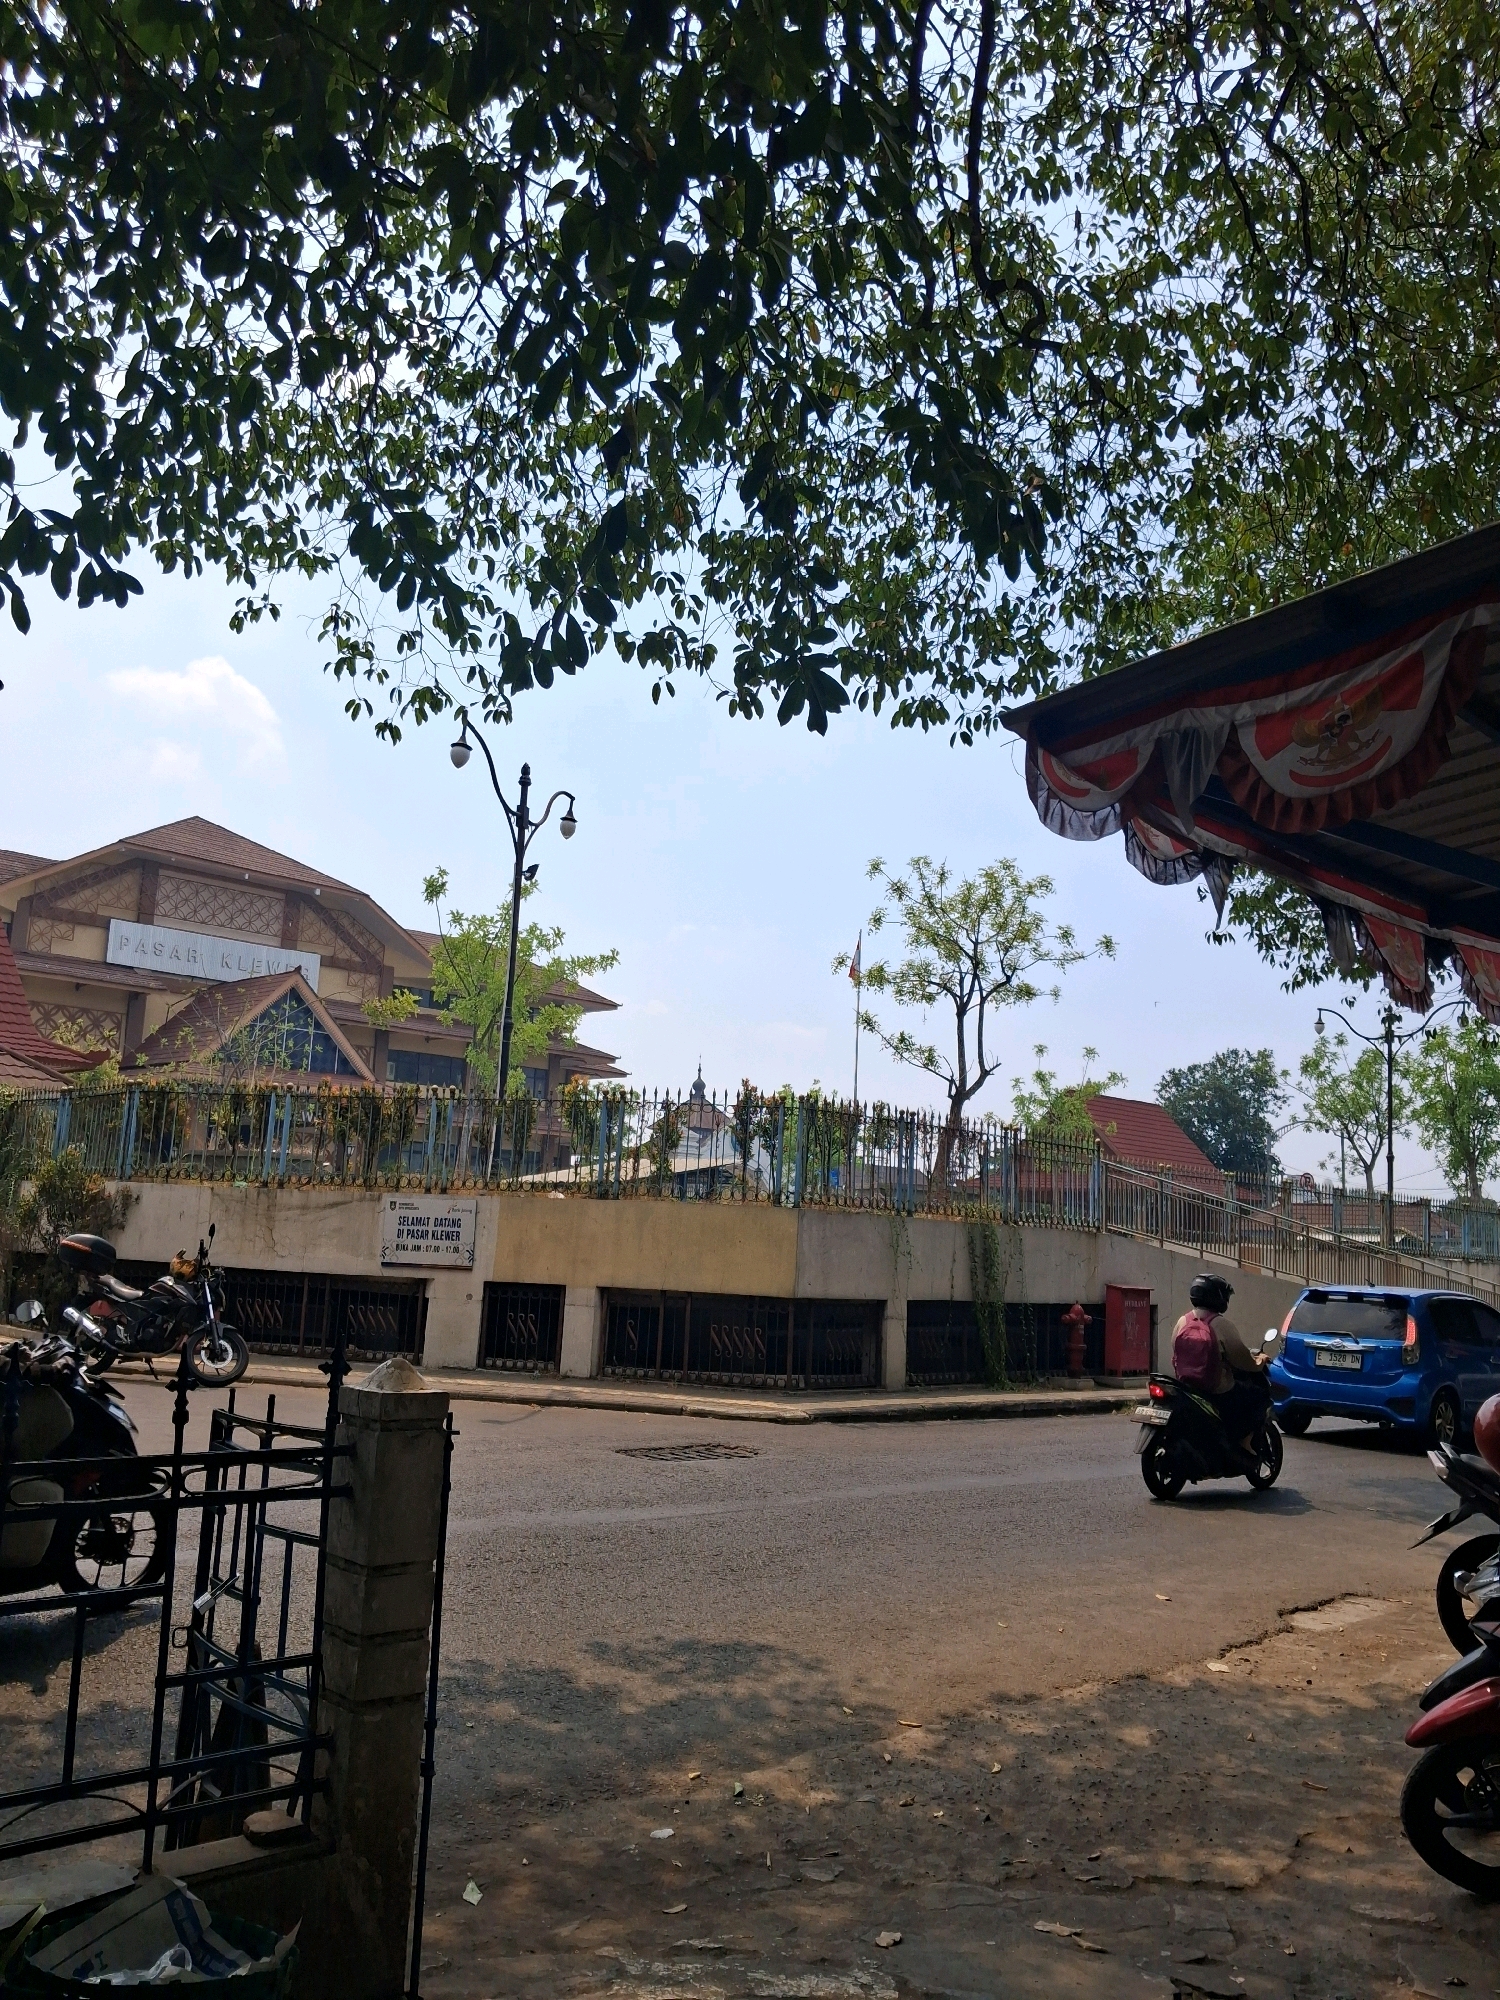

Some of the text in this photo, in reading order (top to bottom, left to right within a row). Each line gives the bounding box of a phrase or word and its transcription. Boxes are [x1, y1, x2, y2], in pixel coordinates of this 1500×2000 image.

[119, 935, 198, 963] PASAR
[398, 1216, 462, 1228] SELAMAT DATANG
[397, 1228, 461, 1241] DI PASAR KLEWER
[395, 1243, 409, 1252] BUKA
[410, 1244, 422, 1252] JAM
[425, 1245, 441, 1253] 07.00
[1318, 1352, 1322, 1360] E
[1350, 1354, 1361, 1364] DN
